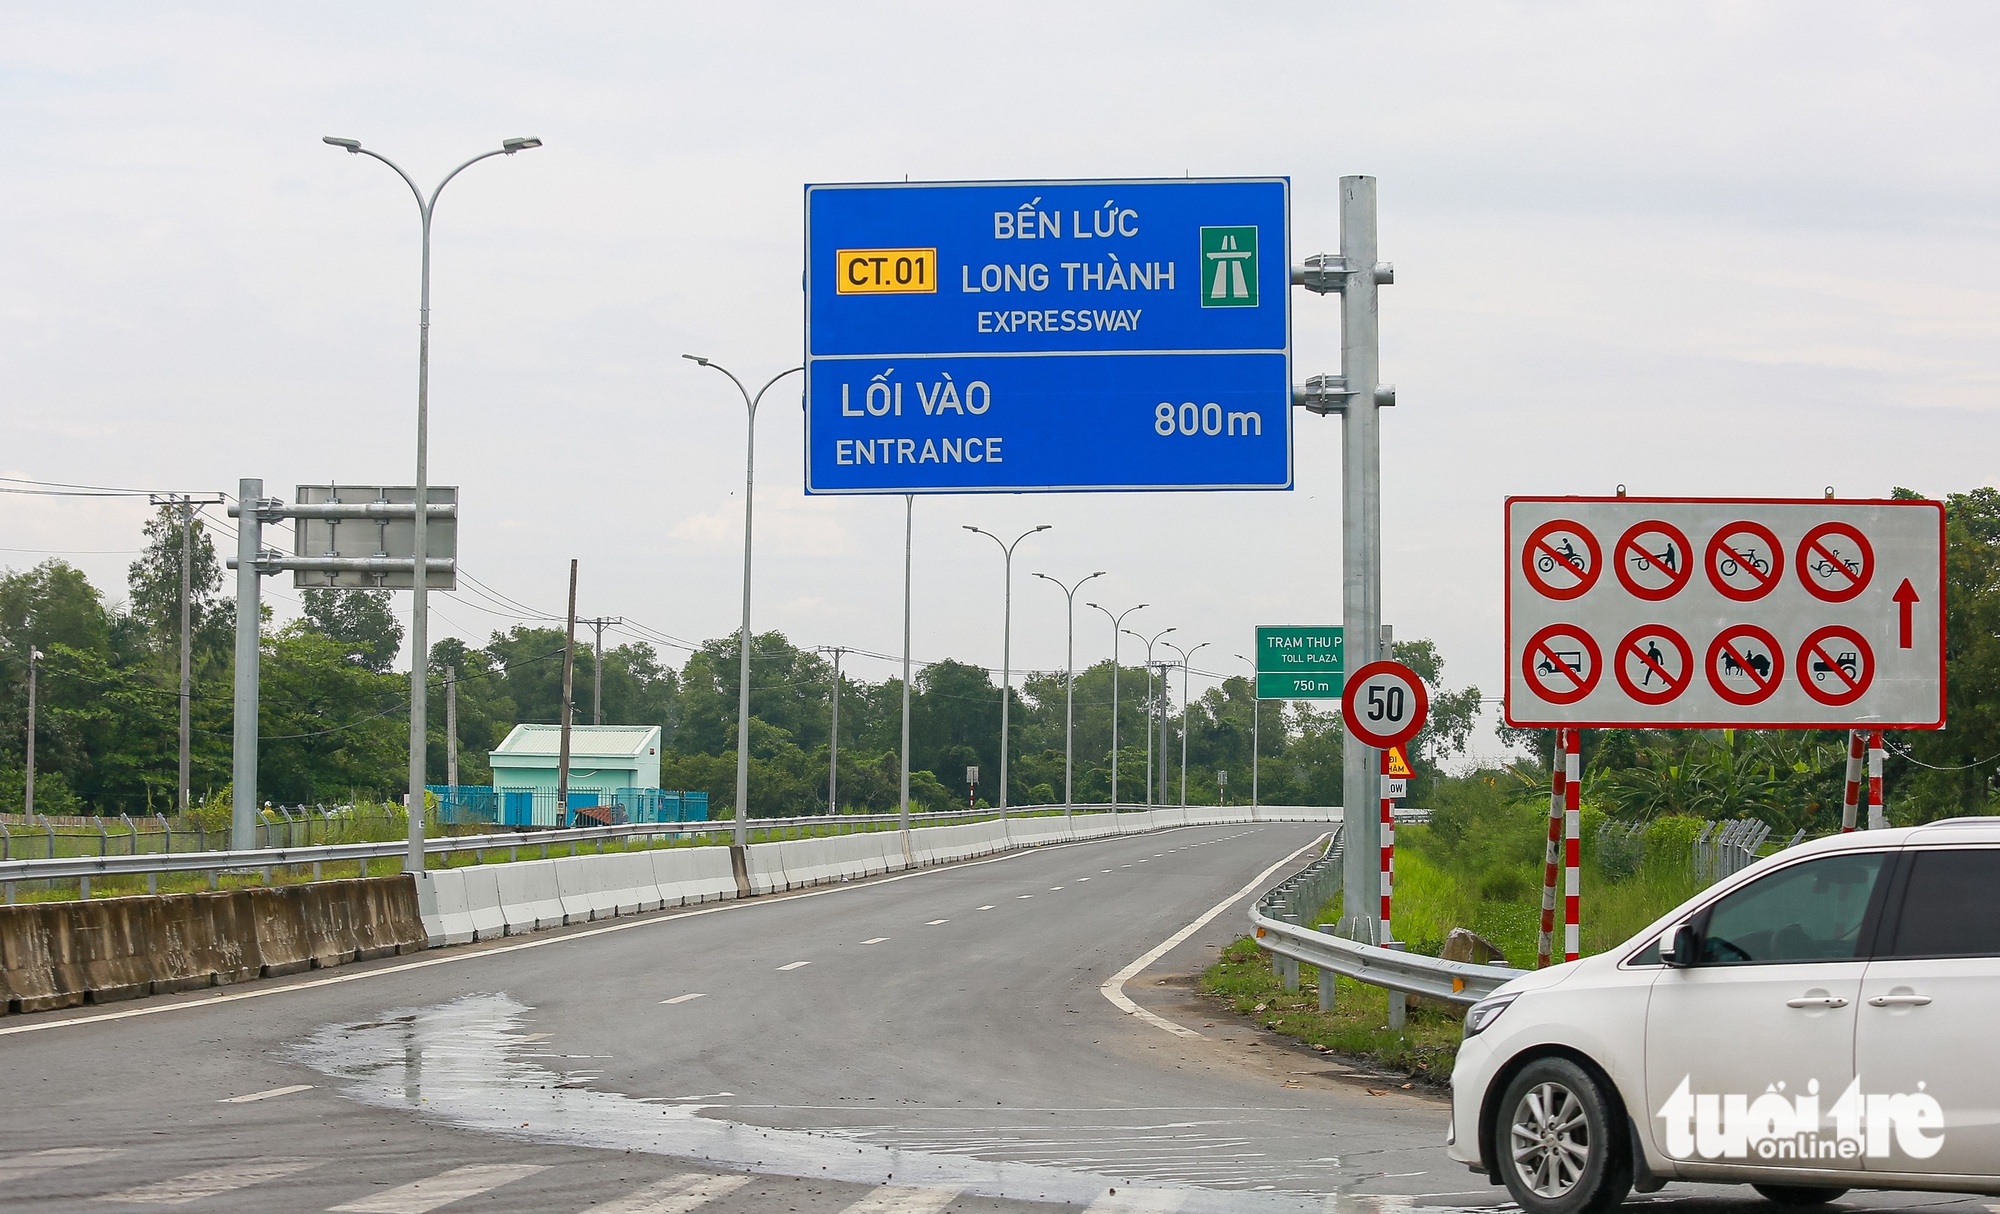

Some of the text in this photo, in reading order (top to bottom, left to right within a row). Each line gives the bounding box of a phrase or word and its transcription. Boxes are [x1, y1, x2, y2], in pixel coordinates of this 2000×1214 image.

[994, 197, 1139, 240] BẾN LỨC
[847, 257, 926, 287] CT.01
[961, 253, 1175, 294] LONG THÀNH
[977, 309, 1142, 333] EXPRESSWAY
[841, 368, 991, 417] LỐI VÀO
[1154, 402, 1262, 437] 800m
[836, 437, 1003, 466] ENTRANCE
[1267, 636, 1302, 650] TRẠM
[1306, 636, 1332, 648] THU
[1282, 654, 1338, 663] TOLL PLAZA
[1293, 680, 1329, 692] 750 m
[1367, 685, 1405, 722] 50
[1389, 783, 1403, 794] OW
